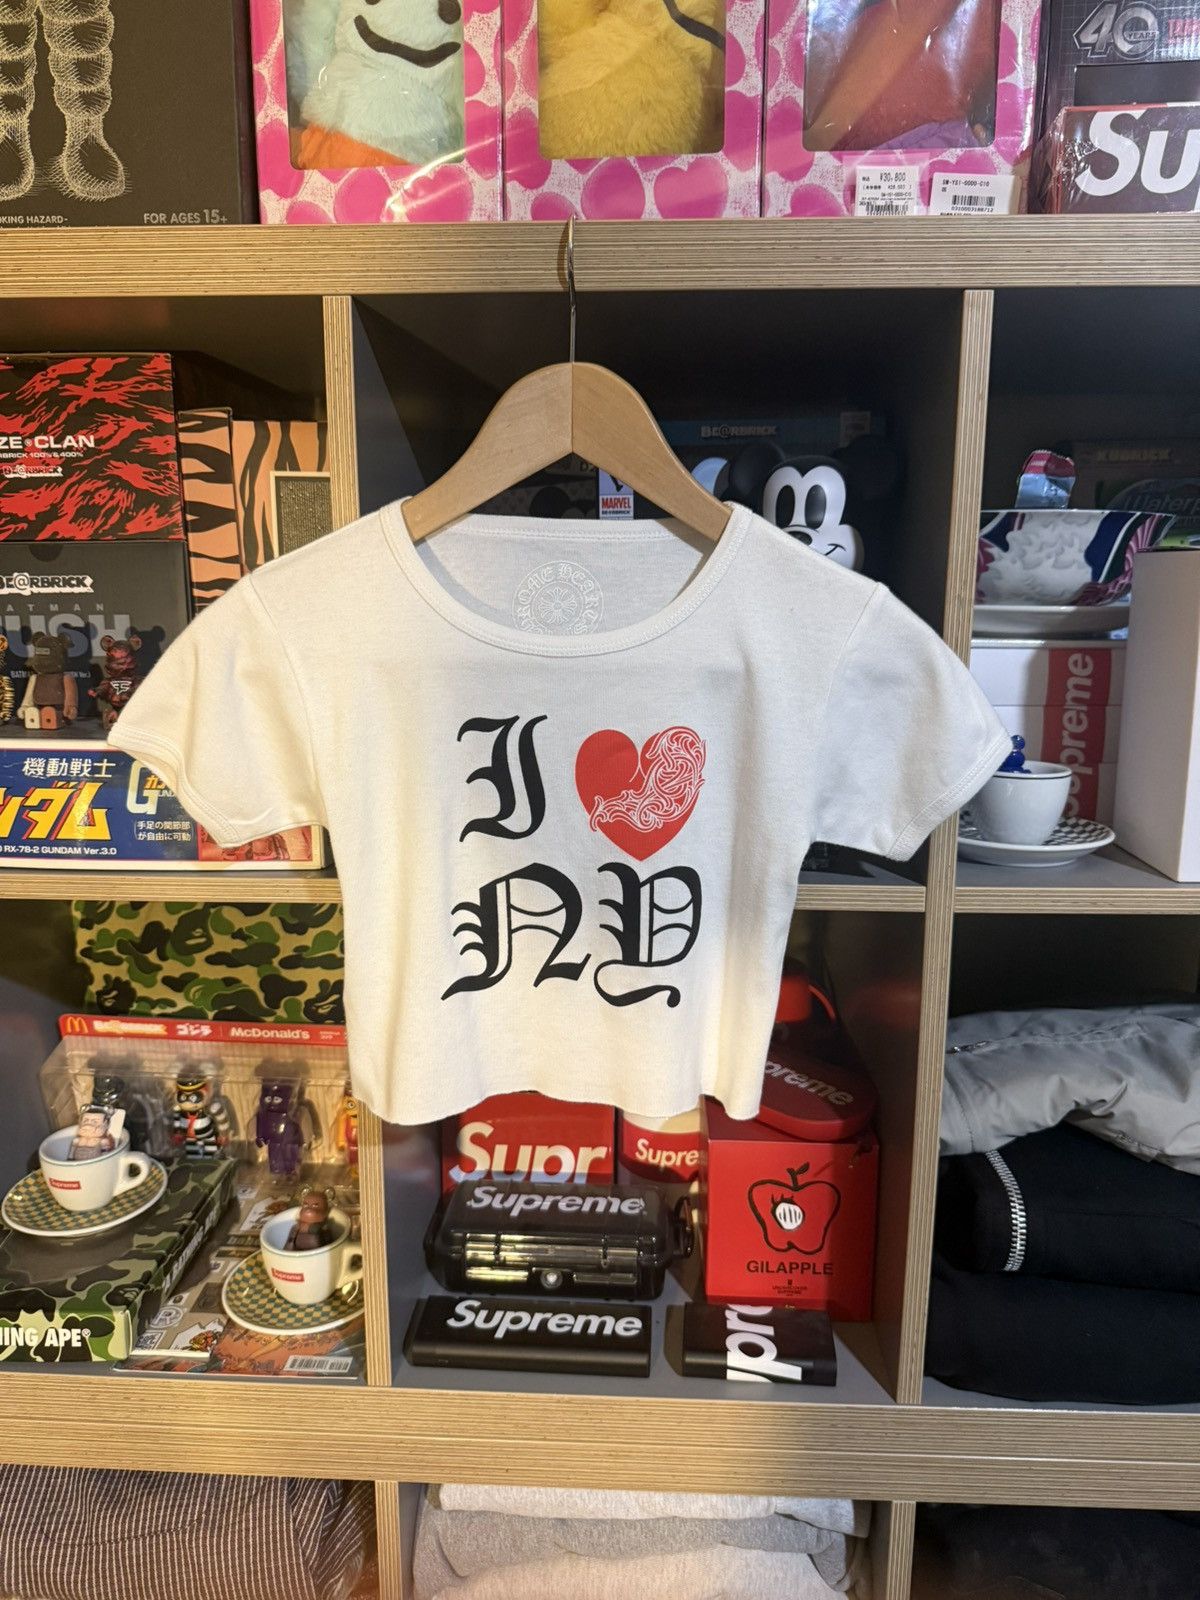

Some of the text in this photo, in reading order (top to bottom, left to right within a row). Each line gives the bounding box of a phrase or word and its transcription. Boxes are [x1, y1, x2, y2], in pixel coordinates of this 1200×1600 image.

[0, 215, 24, 224] KING
[143, 209, 228, 224] FOR AGES 15+
[34, 435, 95, 448] CLAN
[601, 497, 631, 509] MARVEL
[22, 758, 116, 778] 機動戦士
[457, 715, 548, 842] I
[137, 832, 191, 841] が自由に可動
[4, 845, 117, 855] RX-78-2 GUNDAM Ver.3.0
[230, 1026, 310, 1040] McDonald's
[466, 1186, 645, 1217] Supreme
[747, 1260, 834, 1276] GILAPPLE
[447, 1299, 643, 1339] Supreme
